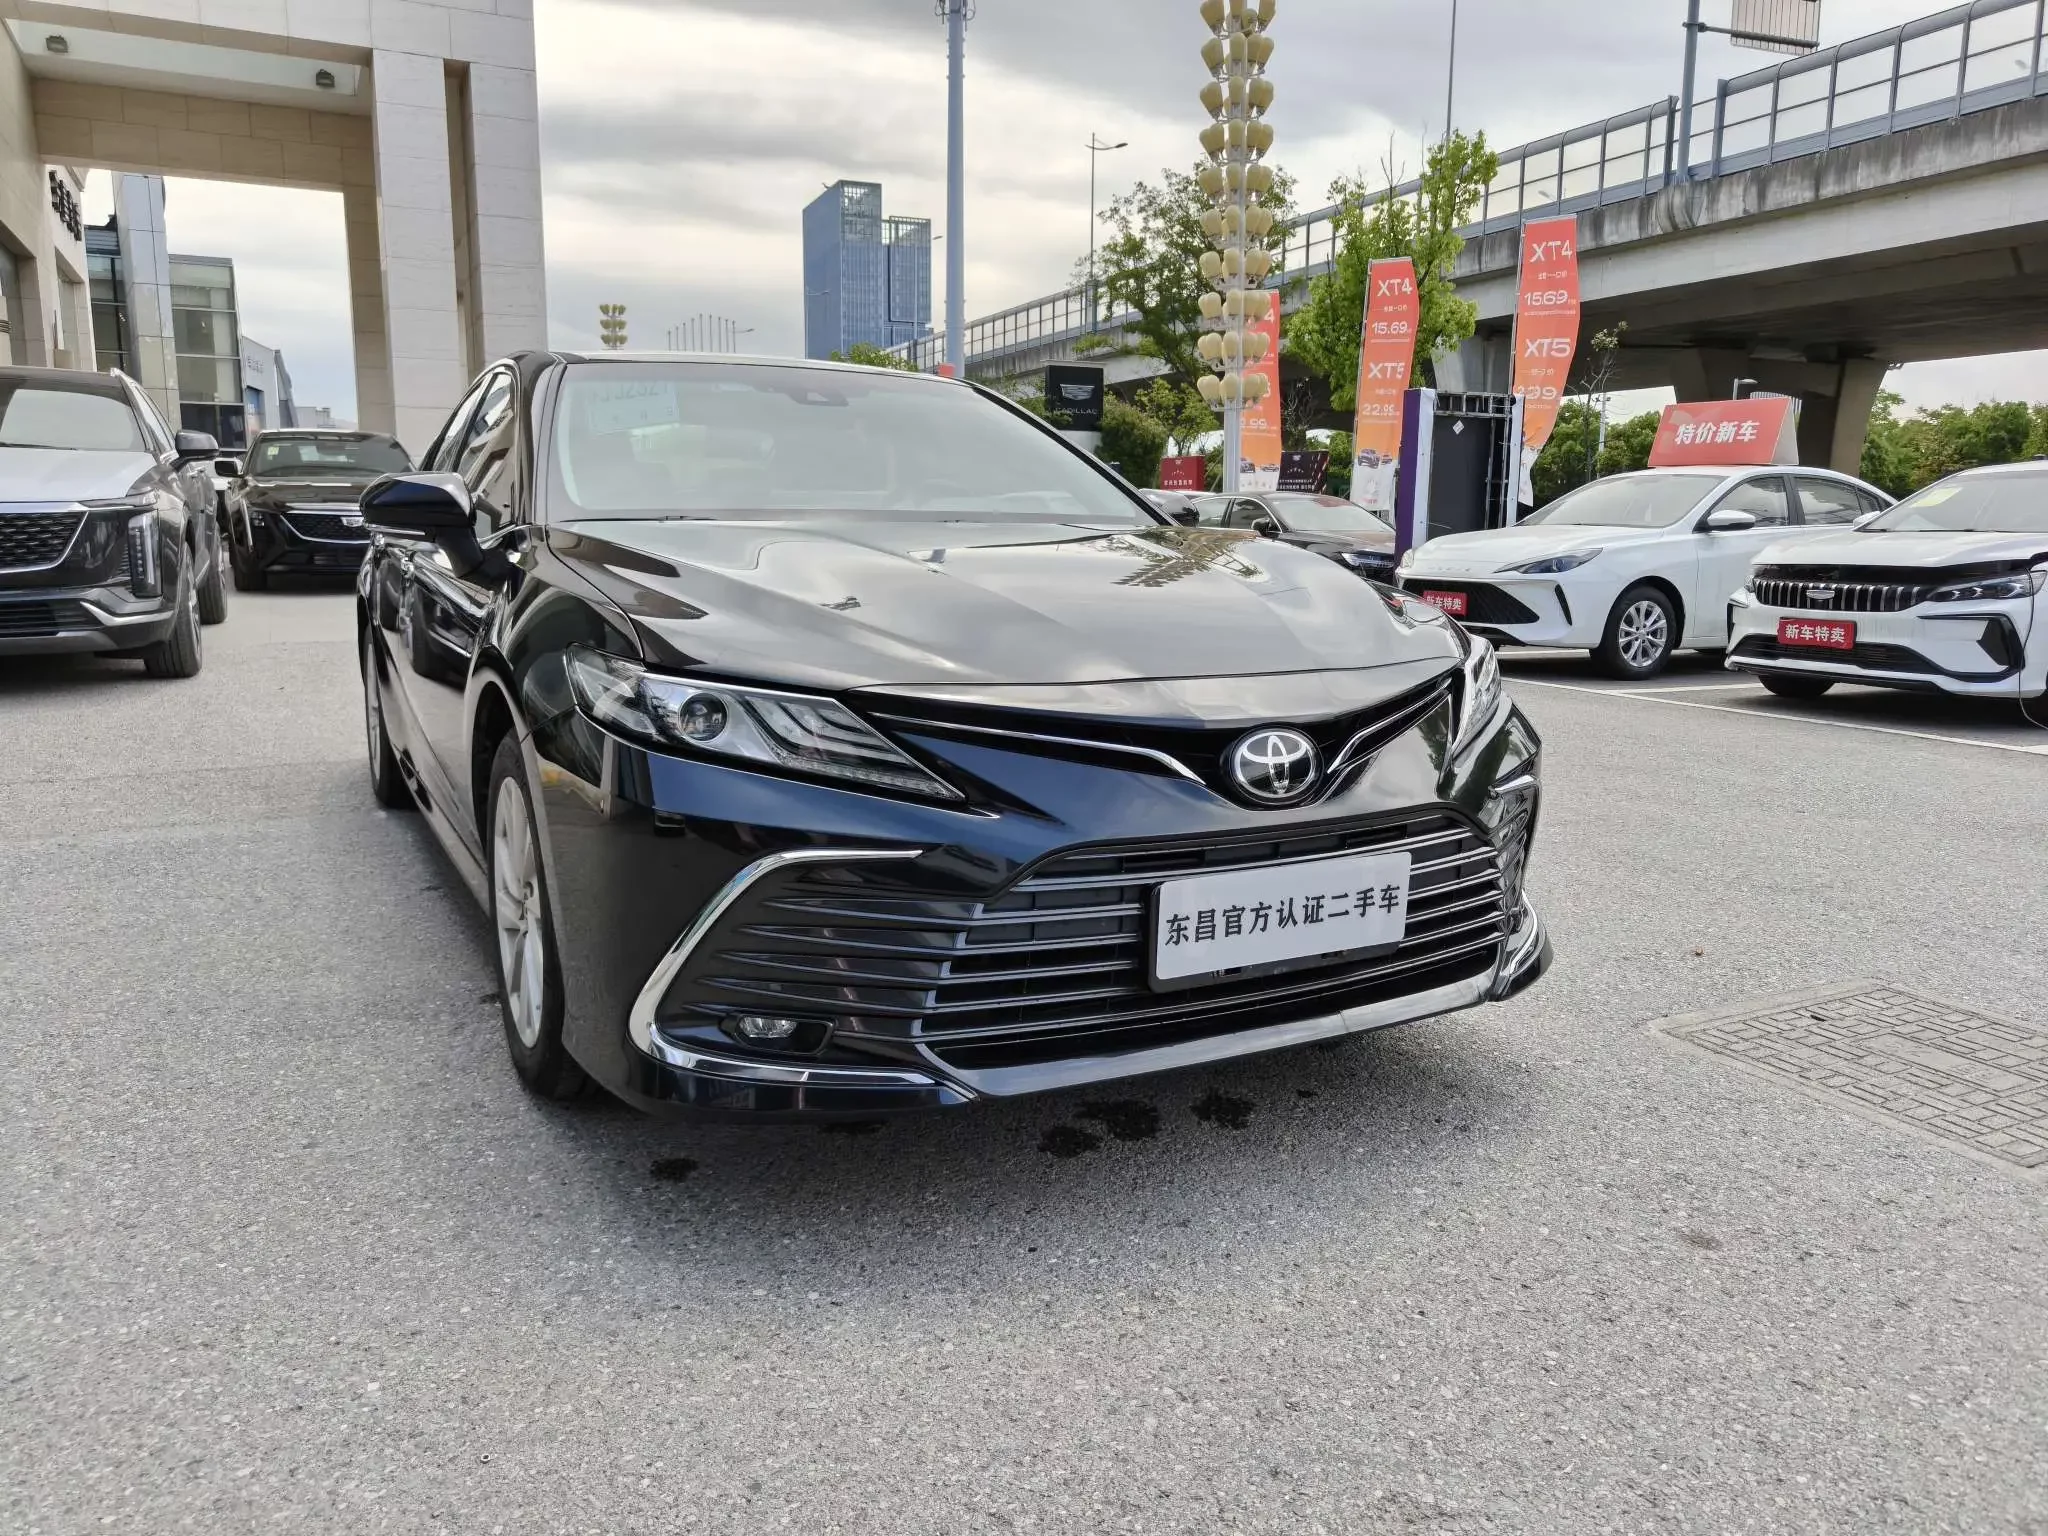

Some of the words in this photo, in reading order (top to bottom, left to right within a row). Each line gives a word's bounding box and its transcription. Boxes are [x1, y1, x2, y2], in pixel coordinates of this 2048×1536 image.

[1530, 240, 1573, 262] XT4
[1377, 278, 1413, 297] XT4
[1372, 321, 1408, 334] 15.69
[1524, 338, 1571, 357] XT5
[1675, 420, 1760, 444] 特价新车
[1785, 624, 1845, 643] 新车特卖
[1165, 884, 1401, 946] 东昌官方认证二手车
